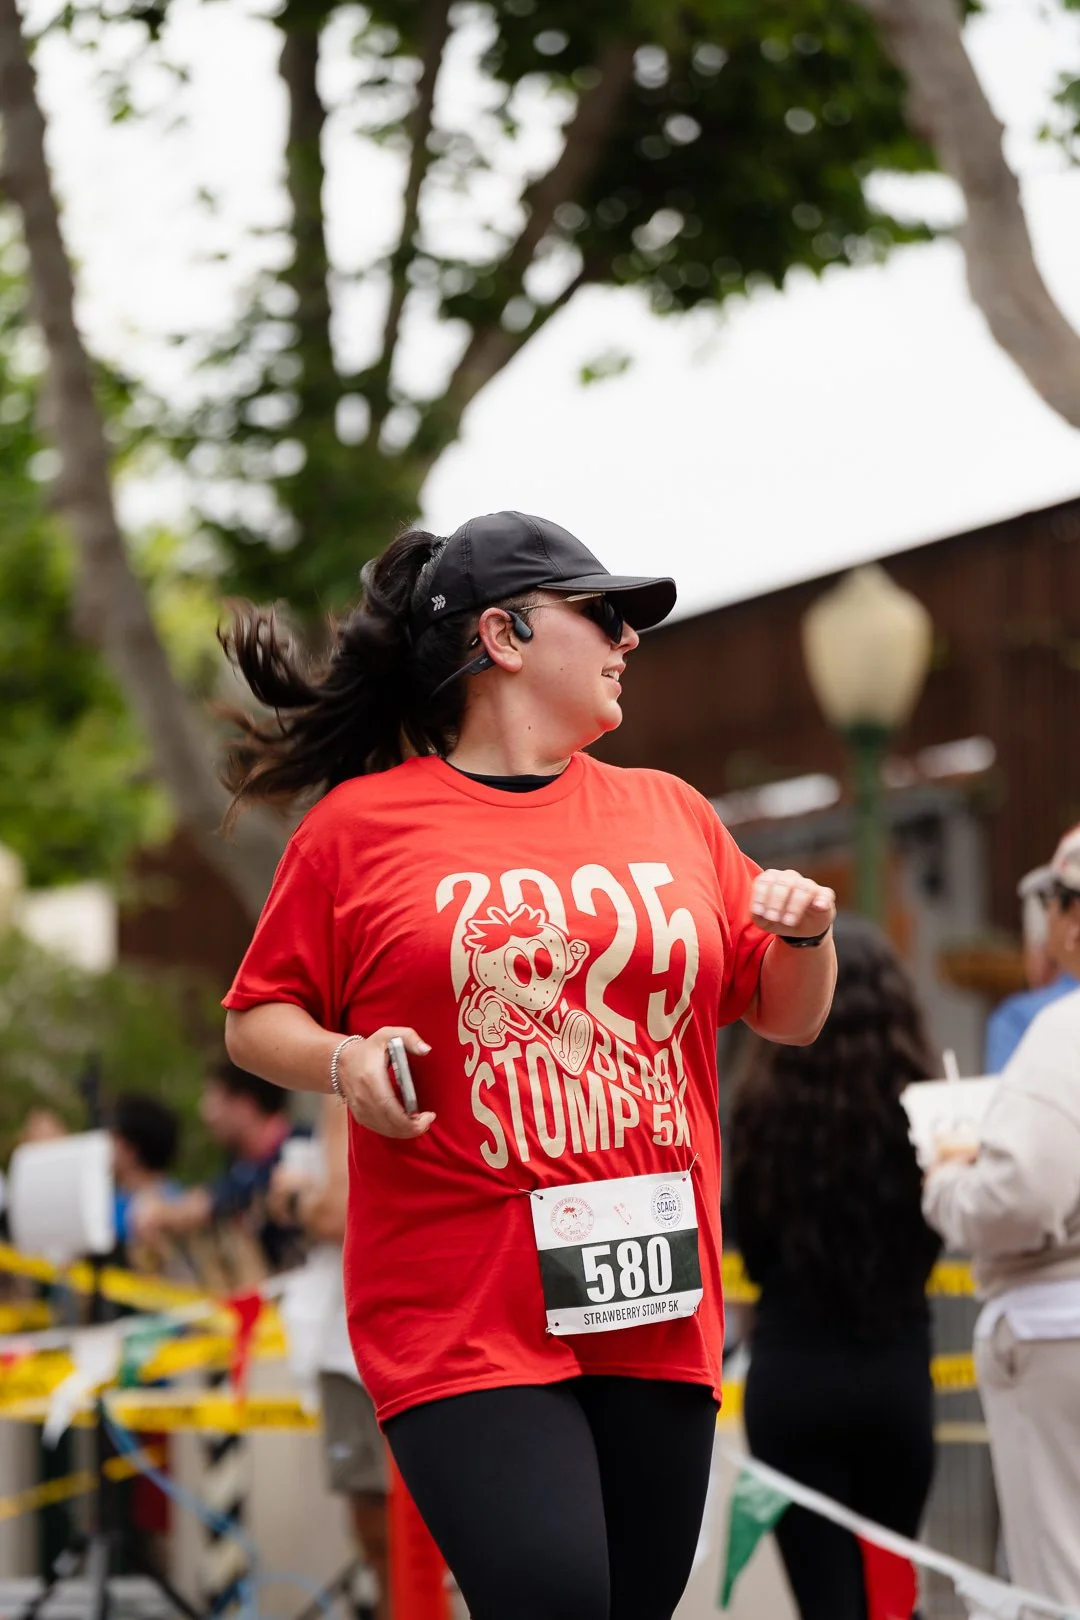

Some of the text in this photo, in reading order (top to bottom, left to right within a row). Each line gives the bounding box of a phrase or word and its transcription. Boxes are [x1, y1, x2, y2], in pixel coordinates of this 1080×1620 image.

[471, 1041, 691, 1169] STOMP 5K
[581, 1236, 673, 1303] 580
[583, 1299, 679, 1326] STRAWBERRY STOMP 5K
